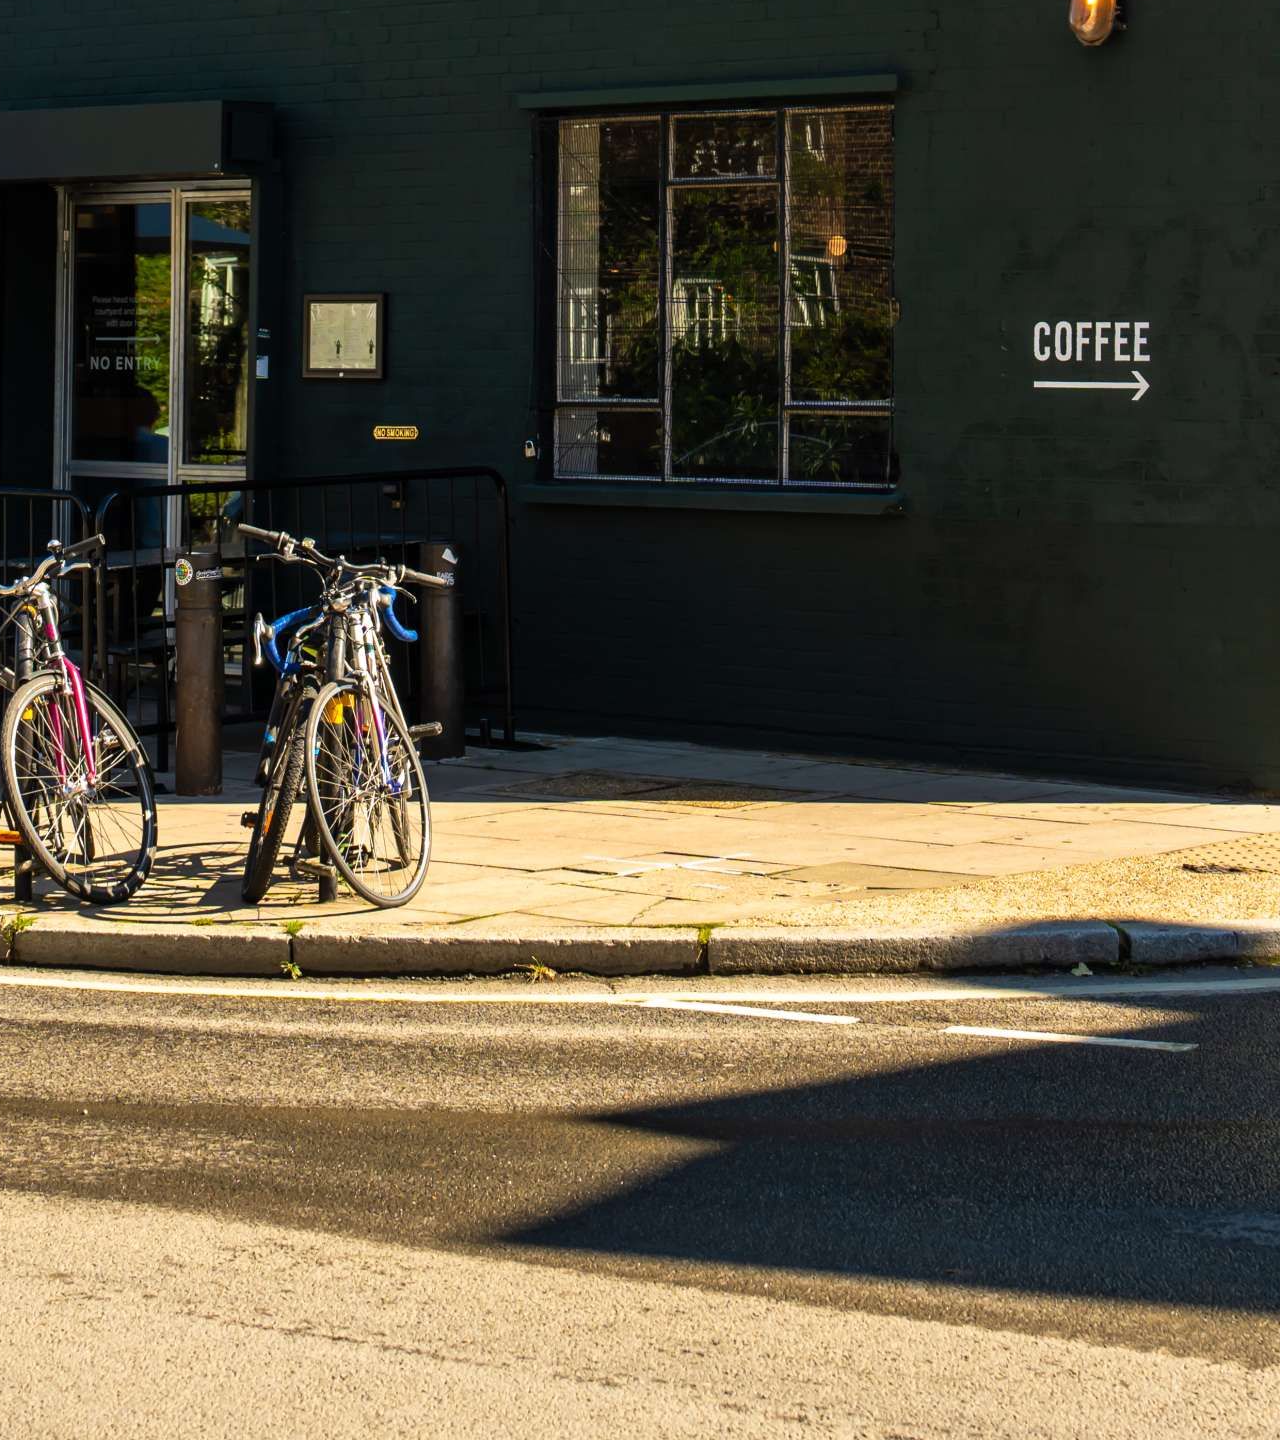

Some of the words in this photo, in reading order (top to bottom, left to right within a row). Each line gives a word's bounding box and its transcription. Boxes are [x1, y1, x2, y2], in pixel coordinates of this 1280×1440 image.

[1034, 321, 1150, 361] COFFEE
[90, 356, 110, 370] NO
[115, 356, 160, 370] ENTRY
[376, 428, 385, 437] NO
[386, 428, 415, 437] SMOKING
